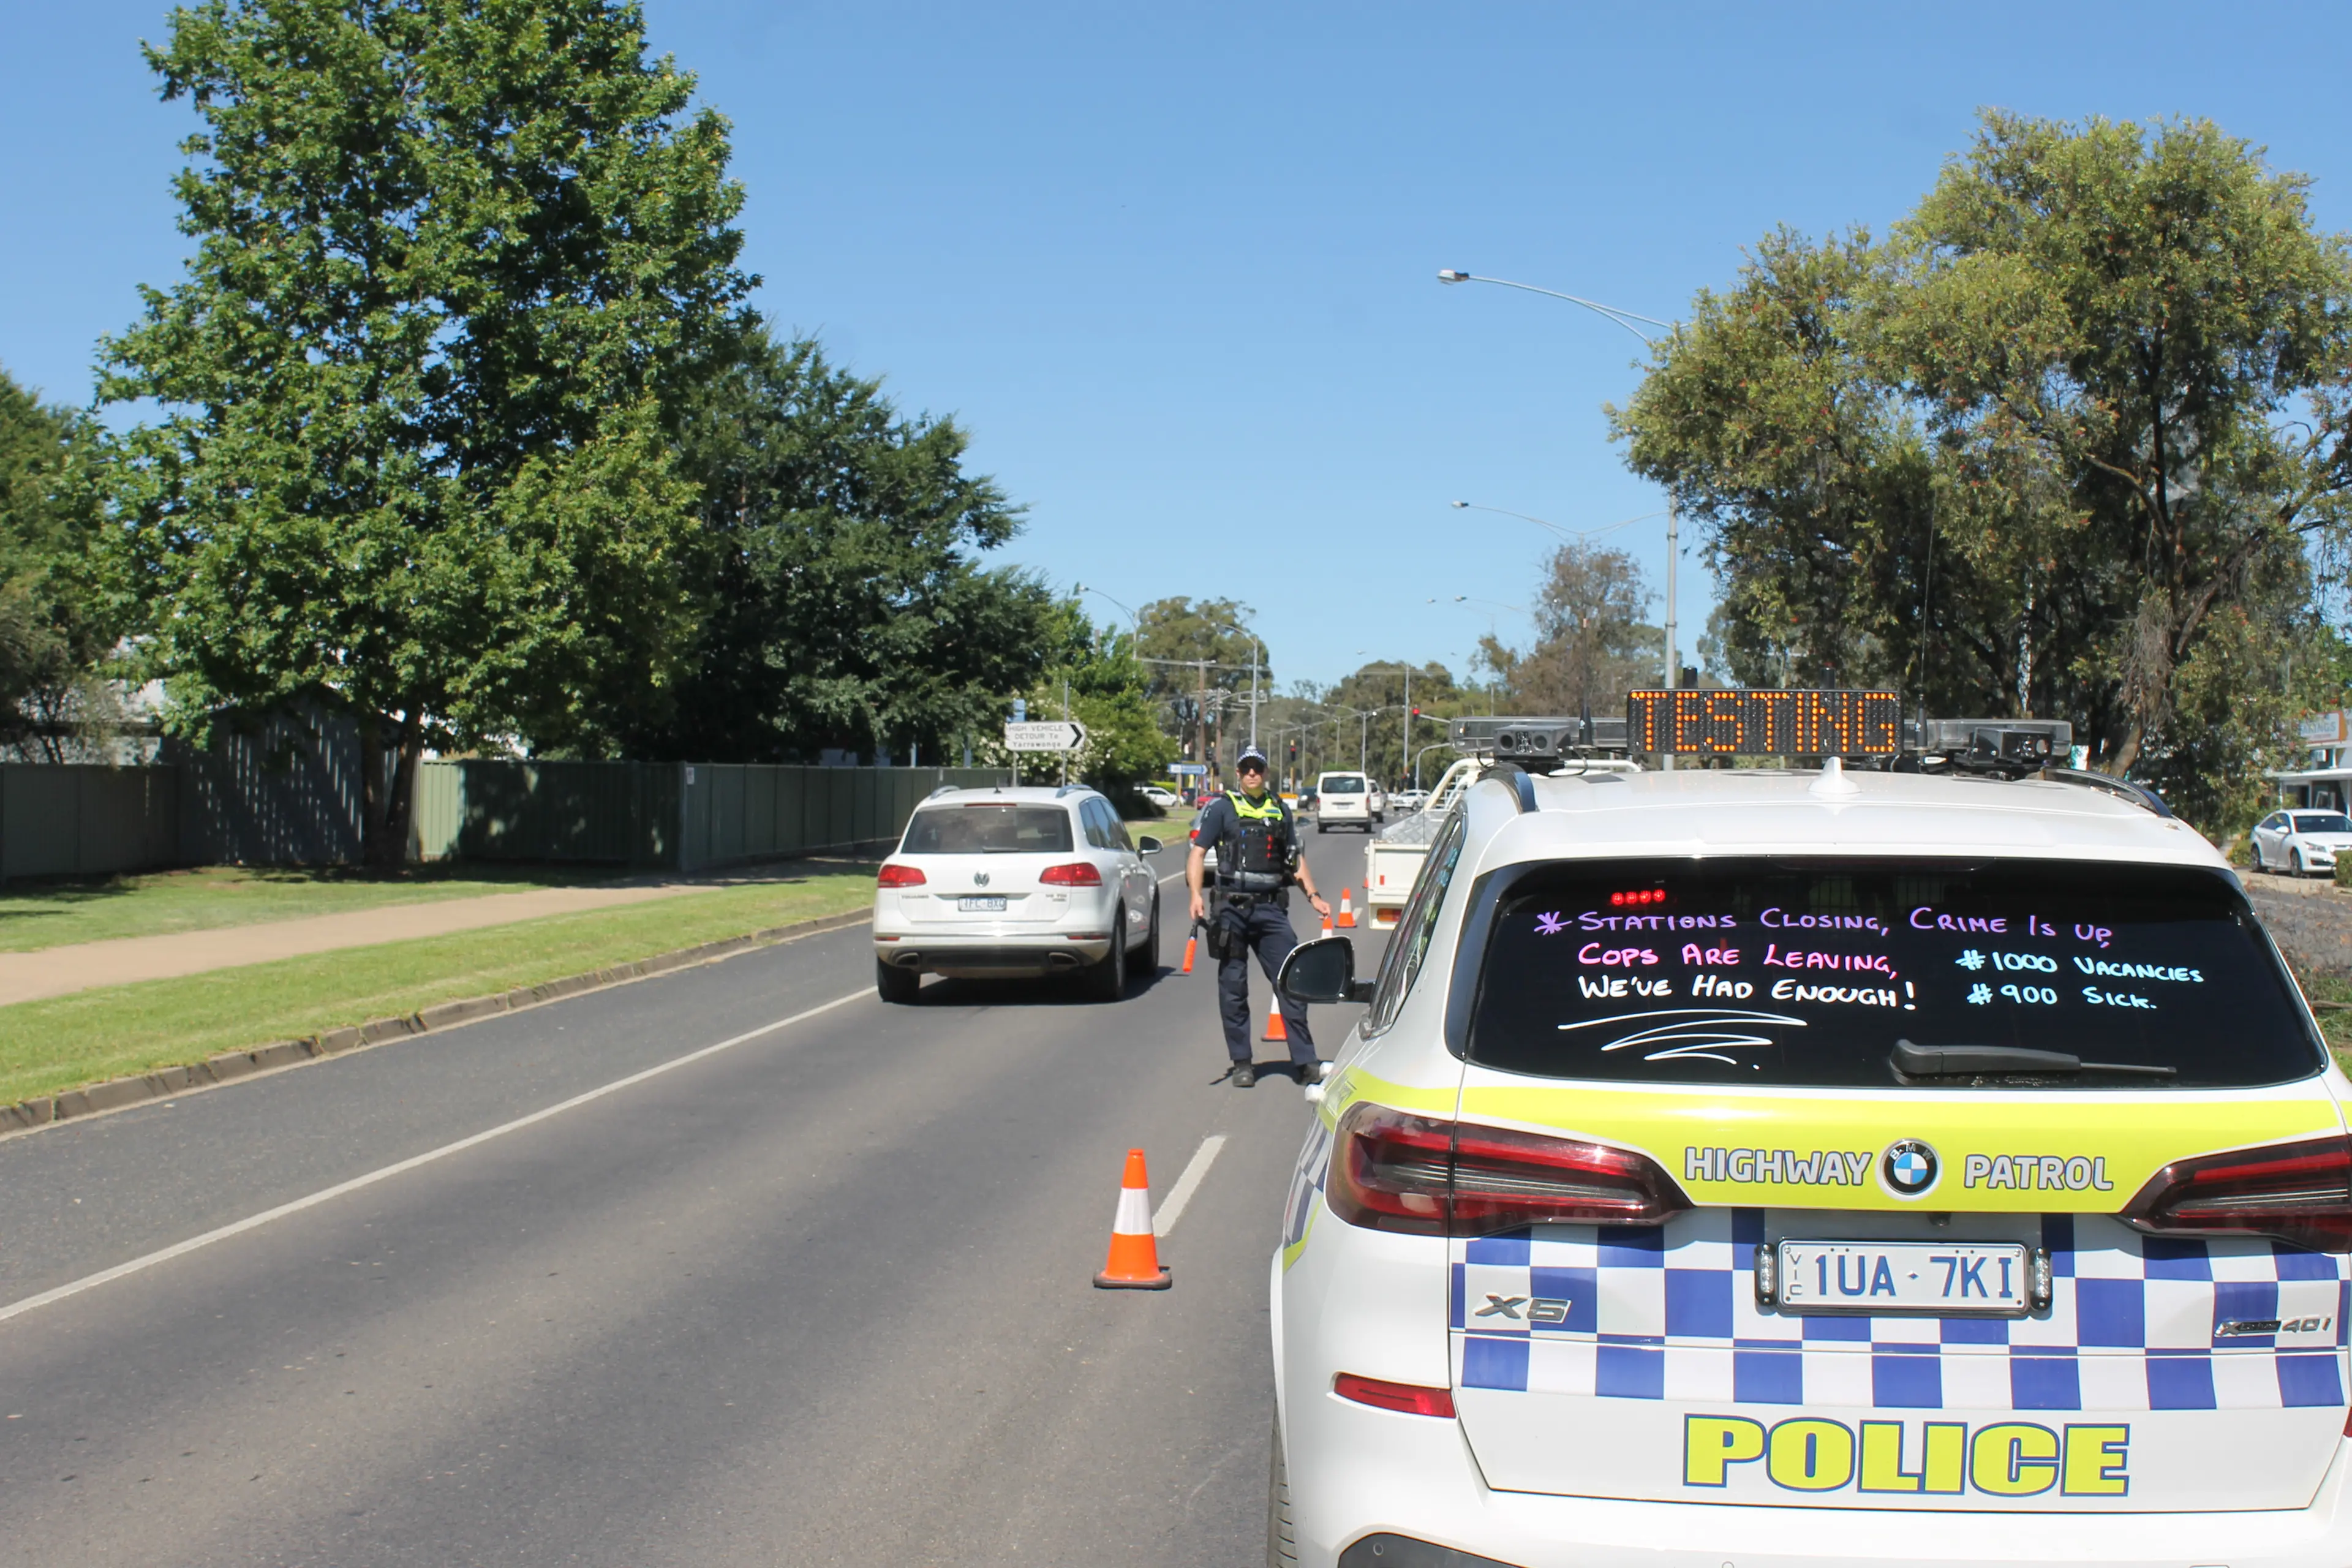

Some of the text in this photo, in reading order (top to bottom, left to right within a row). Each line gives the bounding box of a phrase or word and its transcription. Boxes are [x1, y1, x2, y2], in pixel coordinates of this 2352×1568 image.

[1630, 692, 1895, 752] TESTING
[1684, 1147, 2113, 1190] HIGHWAY PATROL
[1888, 1142, 1934, 1161] BMW
[1683, 1413, 2130, 1498] POLICE
